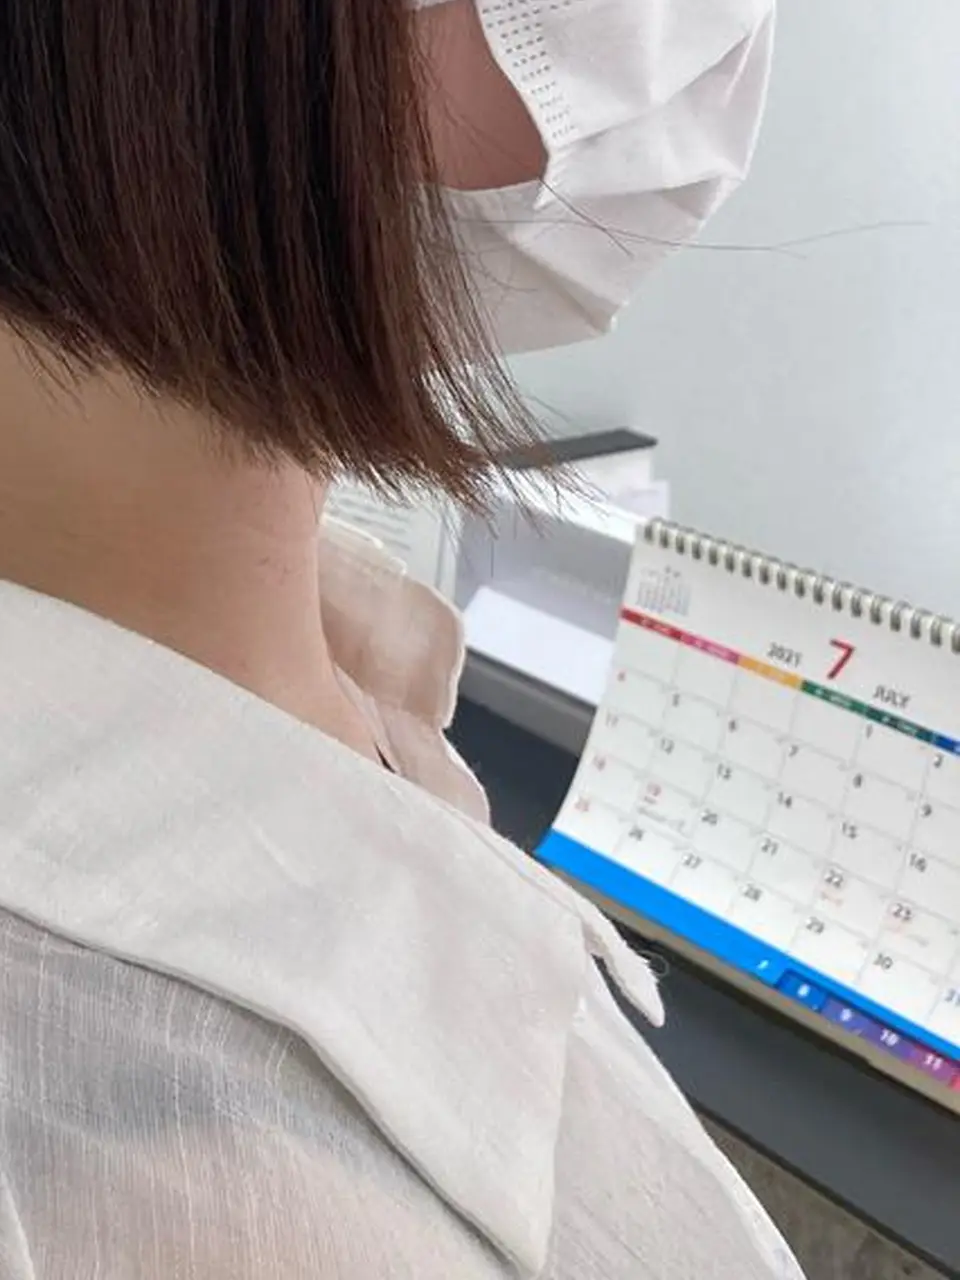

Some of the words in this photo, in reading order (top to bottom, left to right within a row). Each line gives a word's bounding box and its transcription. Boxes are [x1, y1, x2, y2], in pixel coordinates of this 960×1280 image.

[767, 642, 802, 667] 2021
[827, 639, 856, 680] 7
[873, 685, 911, 709] JULY
[825, 870, 843, 888] 22
